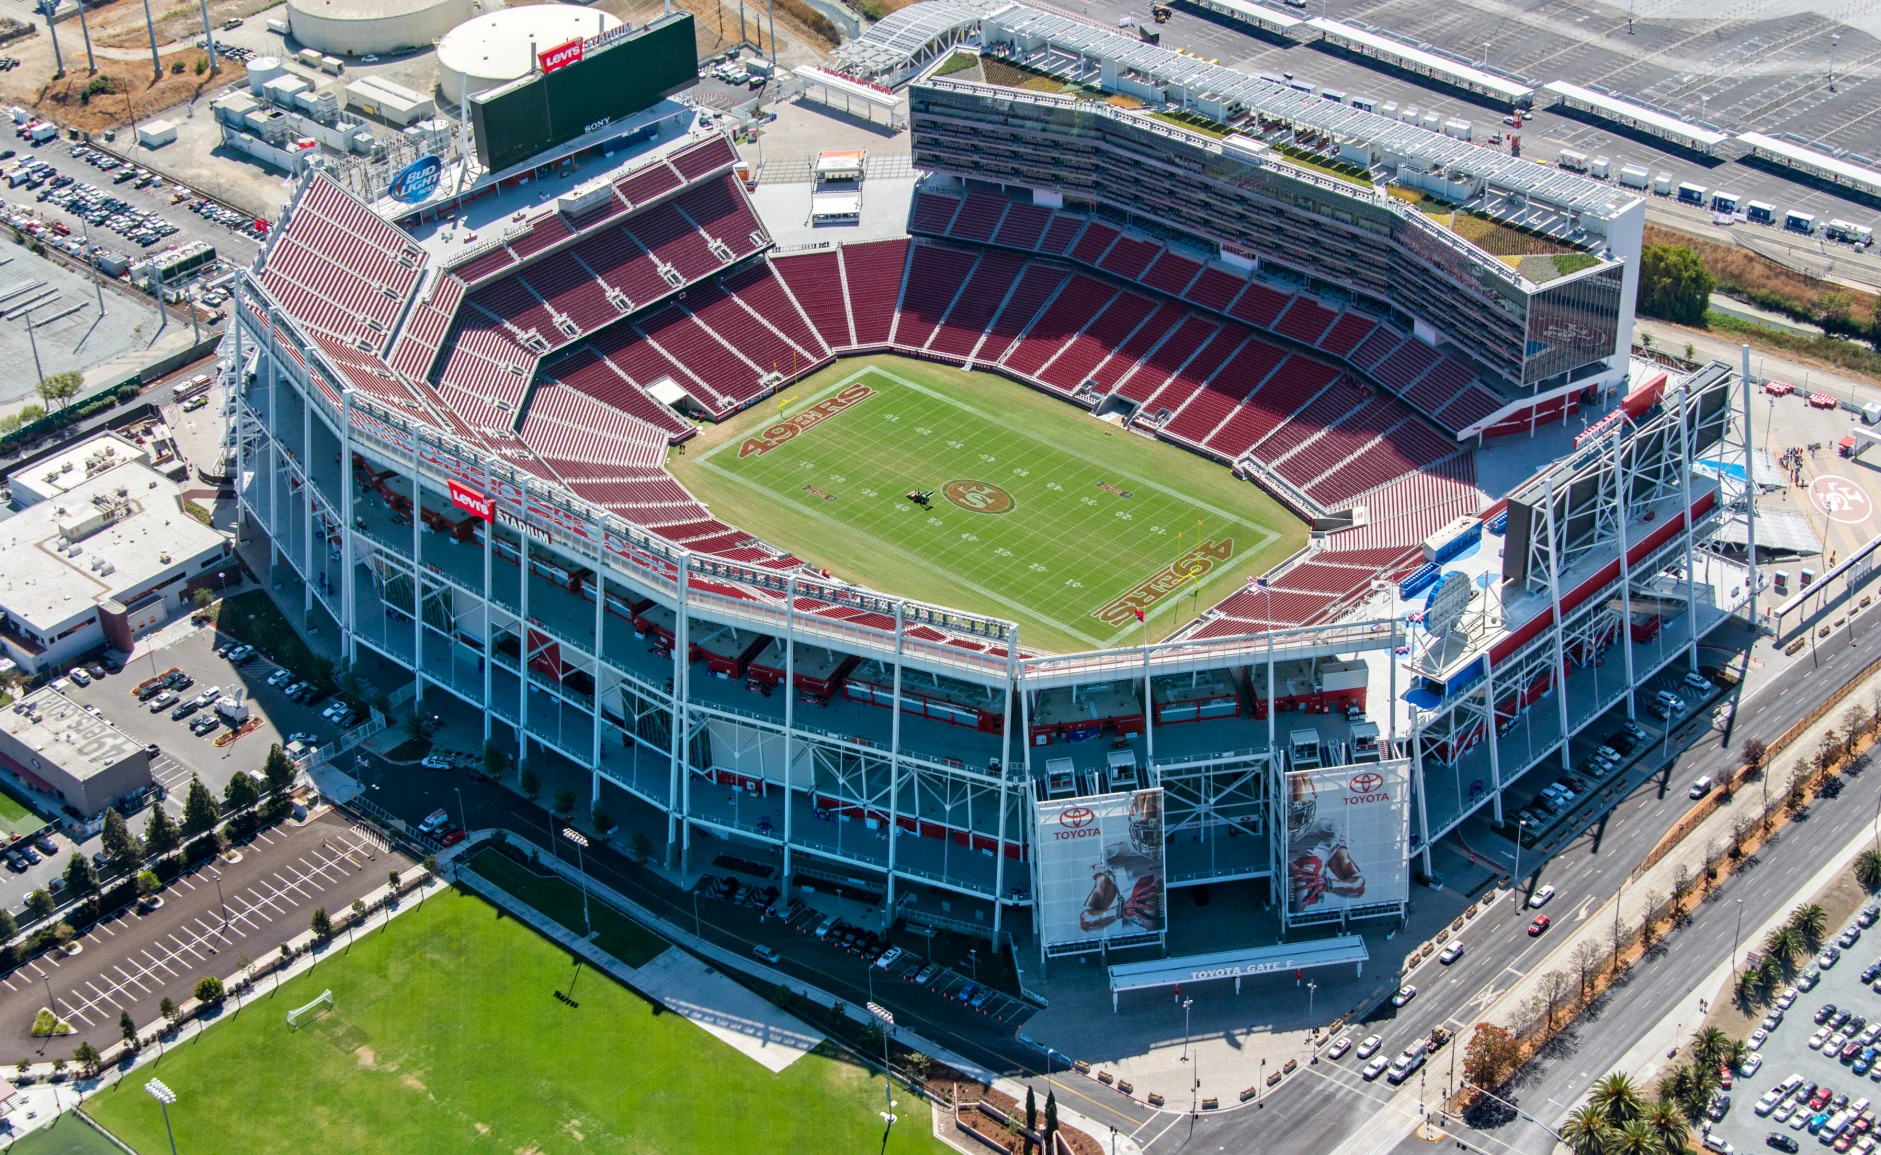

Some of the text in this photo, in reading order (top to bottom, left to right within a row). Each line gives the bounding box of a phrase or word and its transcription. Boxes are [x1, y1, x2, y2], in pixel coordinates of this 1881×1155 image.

[584, 21, 633, 50] STADIUM
[584, 116, 610, 133] SONY
[406, 165, 436, 185] BUD
[400, 172, 440, 196] LIGHT
[418, 184, 435, 196] PATIO
[941, 355, 965, 365] FRANCIS
[737, 383, 879, 459] 49ERS
[885, 413, 899, 422] 10
[916, 427, 932, 436] 20
[949, 440, 964, 449] 30
[980, 454, 996, 463] 40
[801, 461, 814, 469] 10
[1013, 468, 1029, 477] 50
[832, 474, 846, 483] 20
[1046, 482, 1062, 491] 40
[862, 488, 878, 497] 30
[1080, 496, 1096, 506] 30
[895, 503, 910, 512] 40
[1115, 511, 1131, 520] 20
[496, 508, 552, 545] STADIUM
[927, 517, 943, 527] 50
[1150, 526, 1165, 535] 10
[961, 533, 976, 541] 40
[994, 548, 1010, 557] 30
[1029, 563, 1045, 572] 20
[1065, 579, 1080, 588] 10
[1090, 537, 1234, 627] 49ERS
[1343, 793, 1389, 805] TOYOTA
[1053, 828, 1101, 840] TOYOTA
[1190, 960, 1294, 980] TOYOTA GATE F
